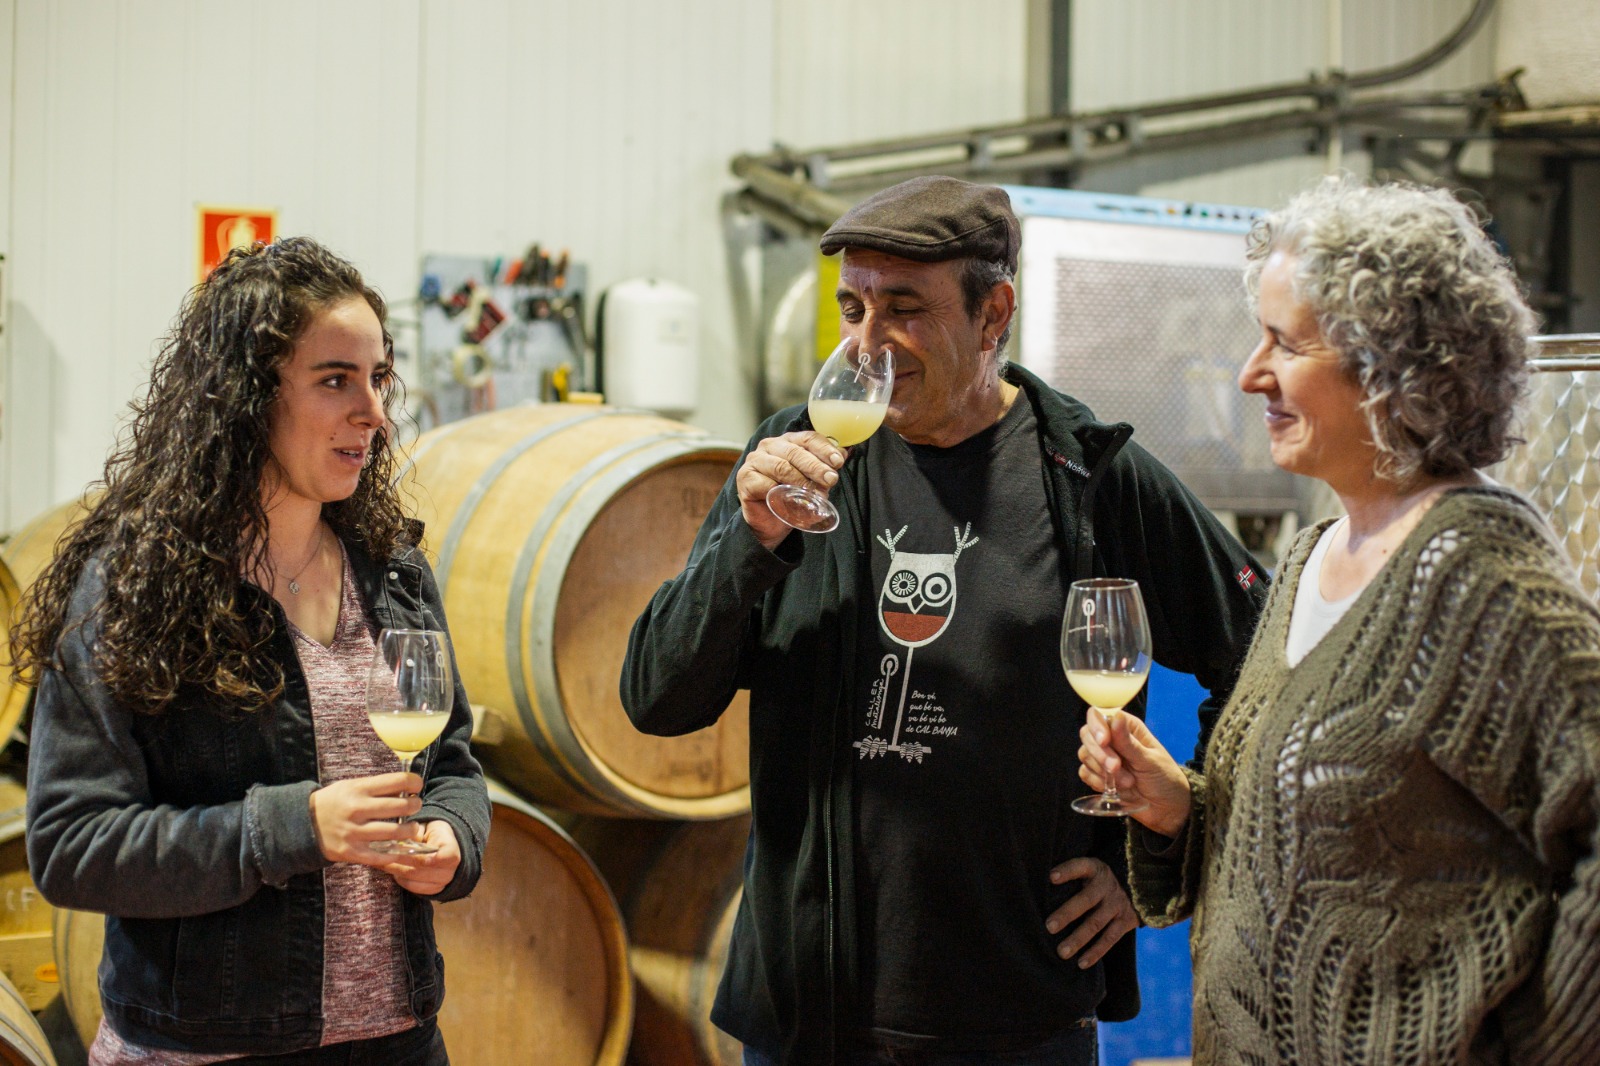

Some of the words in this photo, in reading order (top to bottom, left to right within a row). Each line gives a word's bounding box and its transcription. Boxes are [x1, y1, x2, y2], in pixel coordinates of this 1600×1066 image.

[865, 679, 880, 727] CELLER
[908, 704, 923, 713] que
[905, 724, 914, 733] de
[915, 725, 931, 734] CAL
